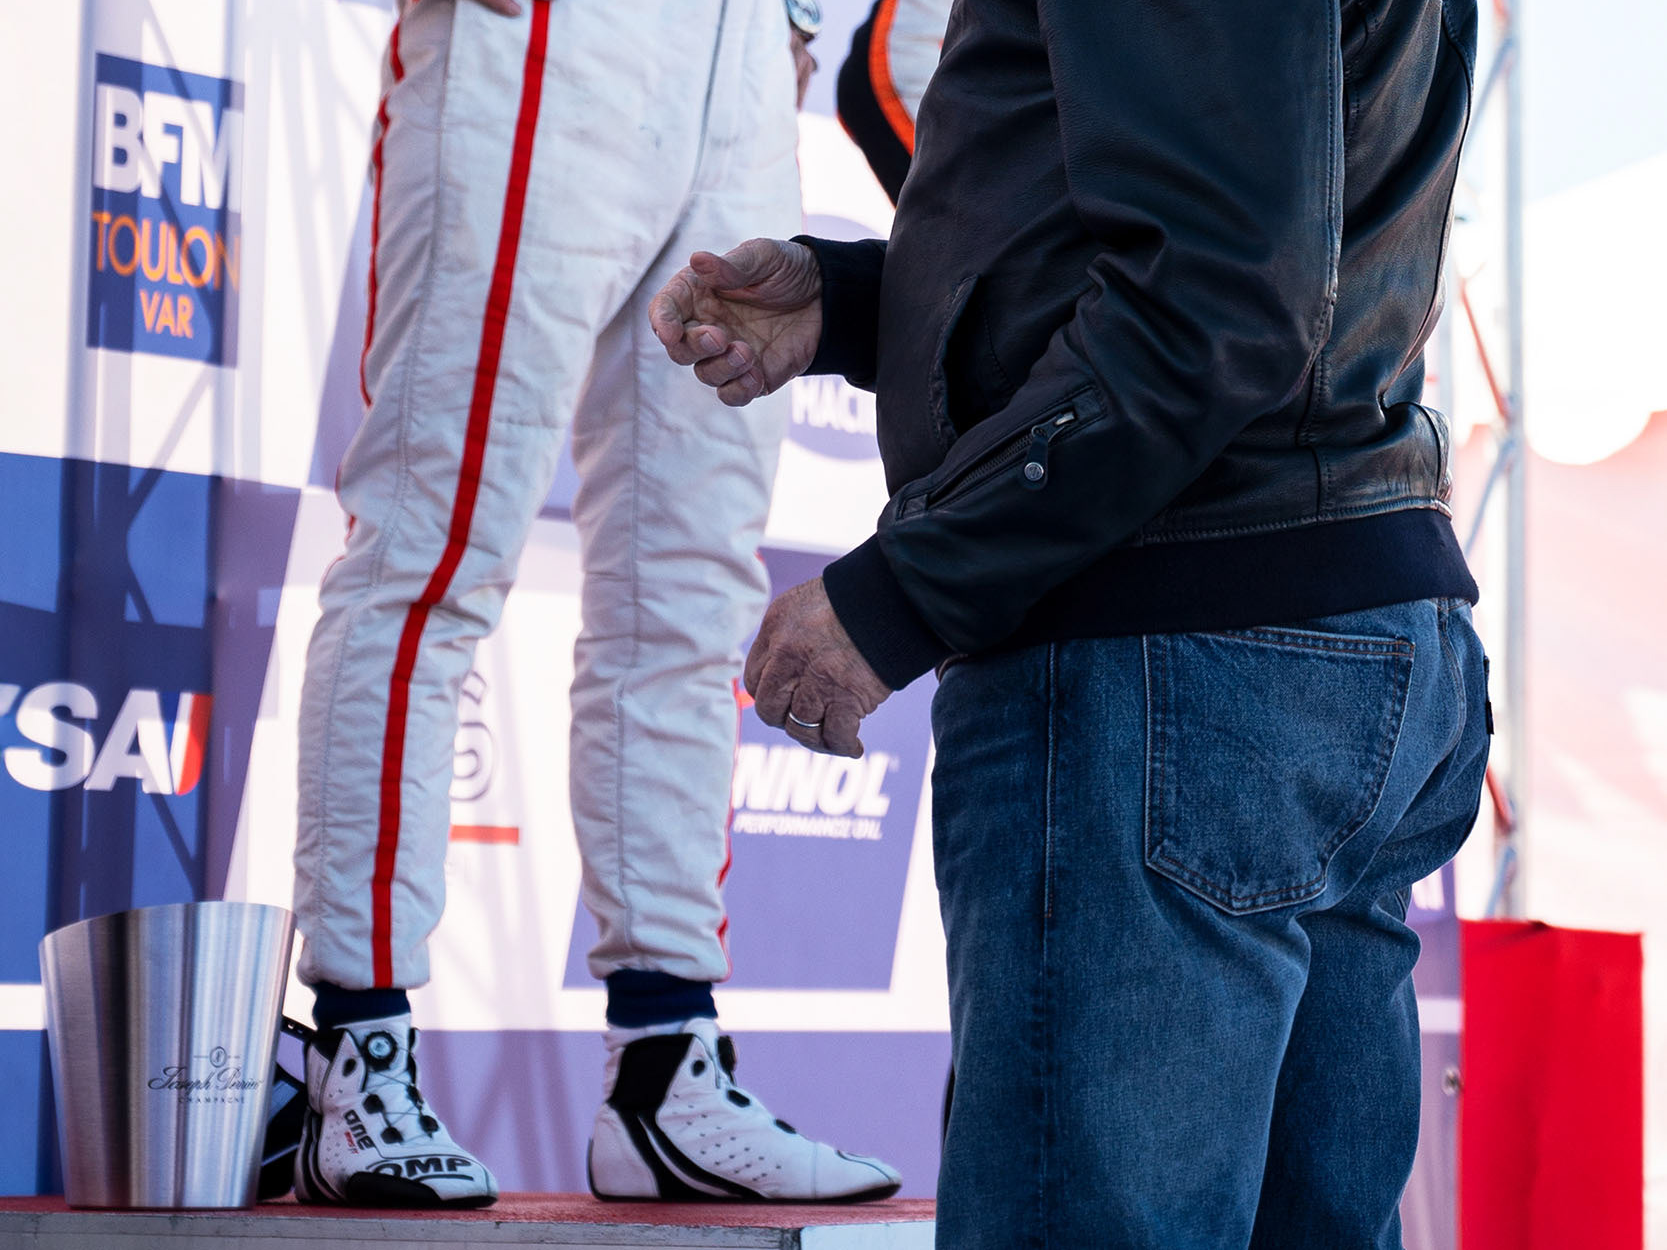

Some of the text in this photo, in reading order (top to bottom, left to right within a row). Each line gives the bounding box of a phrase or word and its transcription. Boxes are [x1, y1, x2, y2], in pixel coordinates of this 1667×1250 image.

[93, 82, 243, 213] BFM
[92, 210, 241, 291] TOULON
[139, 288, 194, 339] VAR
[0, 681, 173, 795] SA
[732, 743, 891, 818] NNOL
[147, 1066, 215, 1095] Joseph
[178, 1096, 245, 1105] CHAMPAGNE
